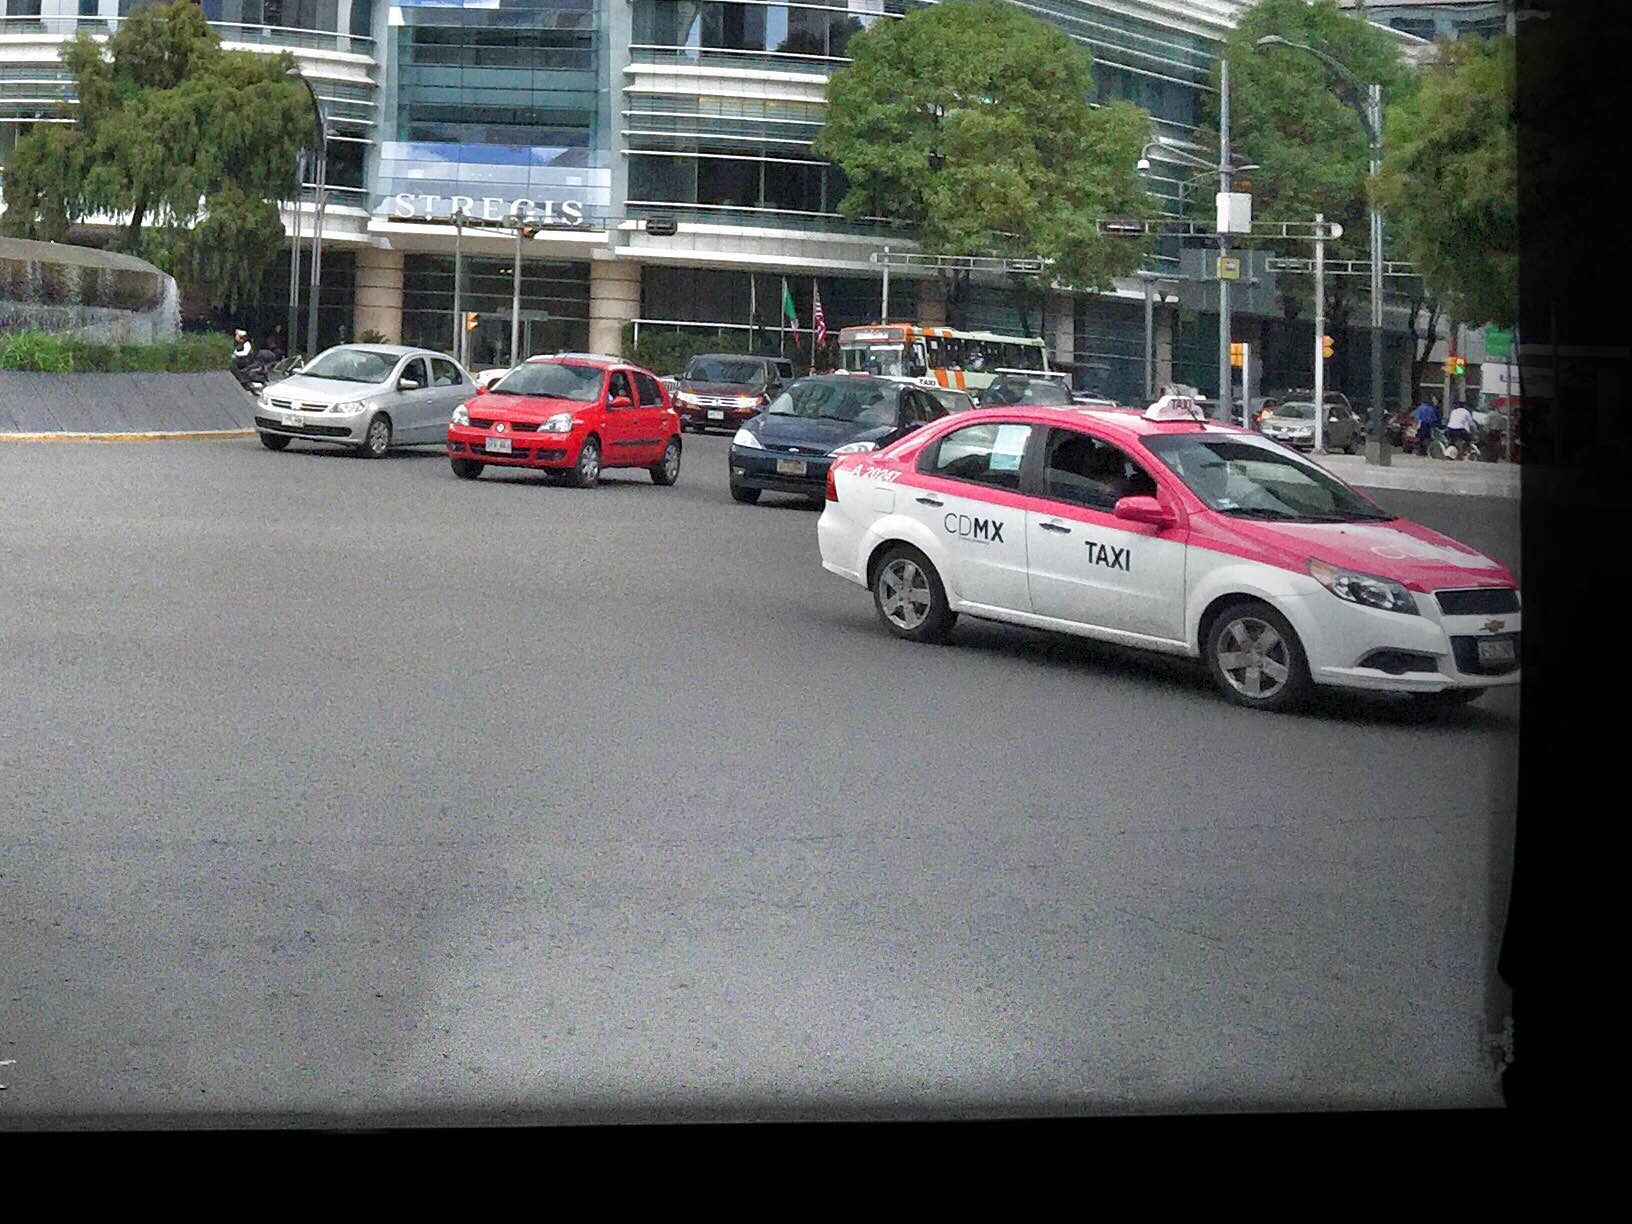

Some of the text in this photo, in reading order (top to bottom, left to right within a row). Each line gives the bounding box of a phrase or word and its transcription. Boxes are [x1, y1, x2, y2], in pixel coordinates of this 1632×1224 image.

[451, 195, 583, 225] REGIS
[943, 512, 1005, 544] CDMX
[1084, 540, 1131, 572] TAXI
